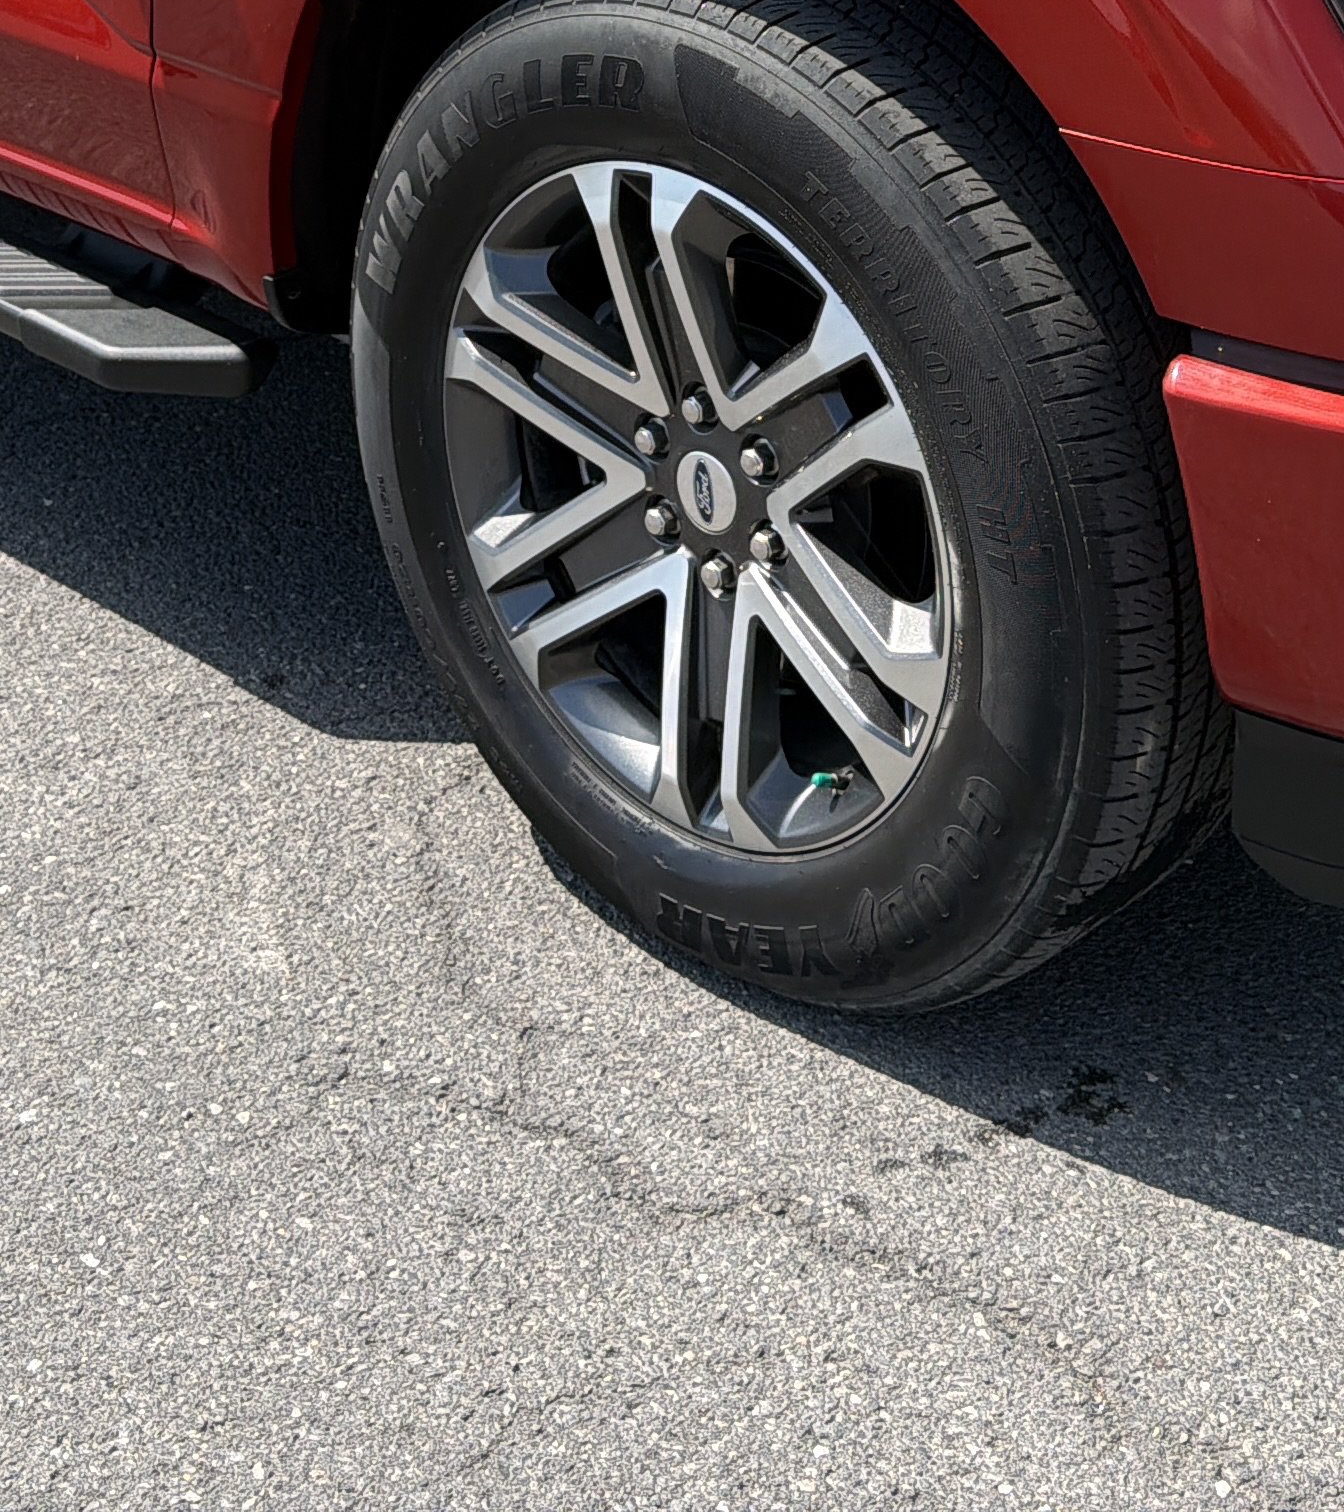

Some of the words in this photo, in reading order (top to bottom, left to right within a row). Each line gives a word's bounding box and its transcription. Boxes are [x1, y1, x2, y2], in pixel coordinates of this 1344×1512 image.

[365, 51, 645, 296] WRANGLER
[802, 170, 991, 466] TERRITORY
[695, 469, 713, 516] Ford
